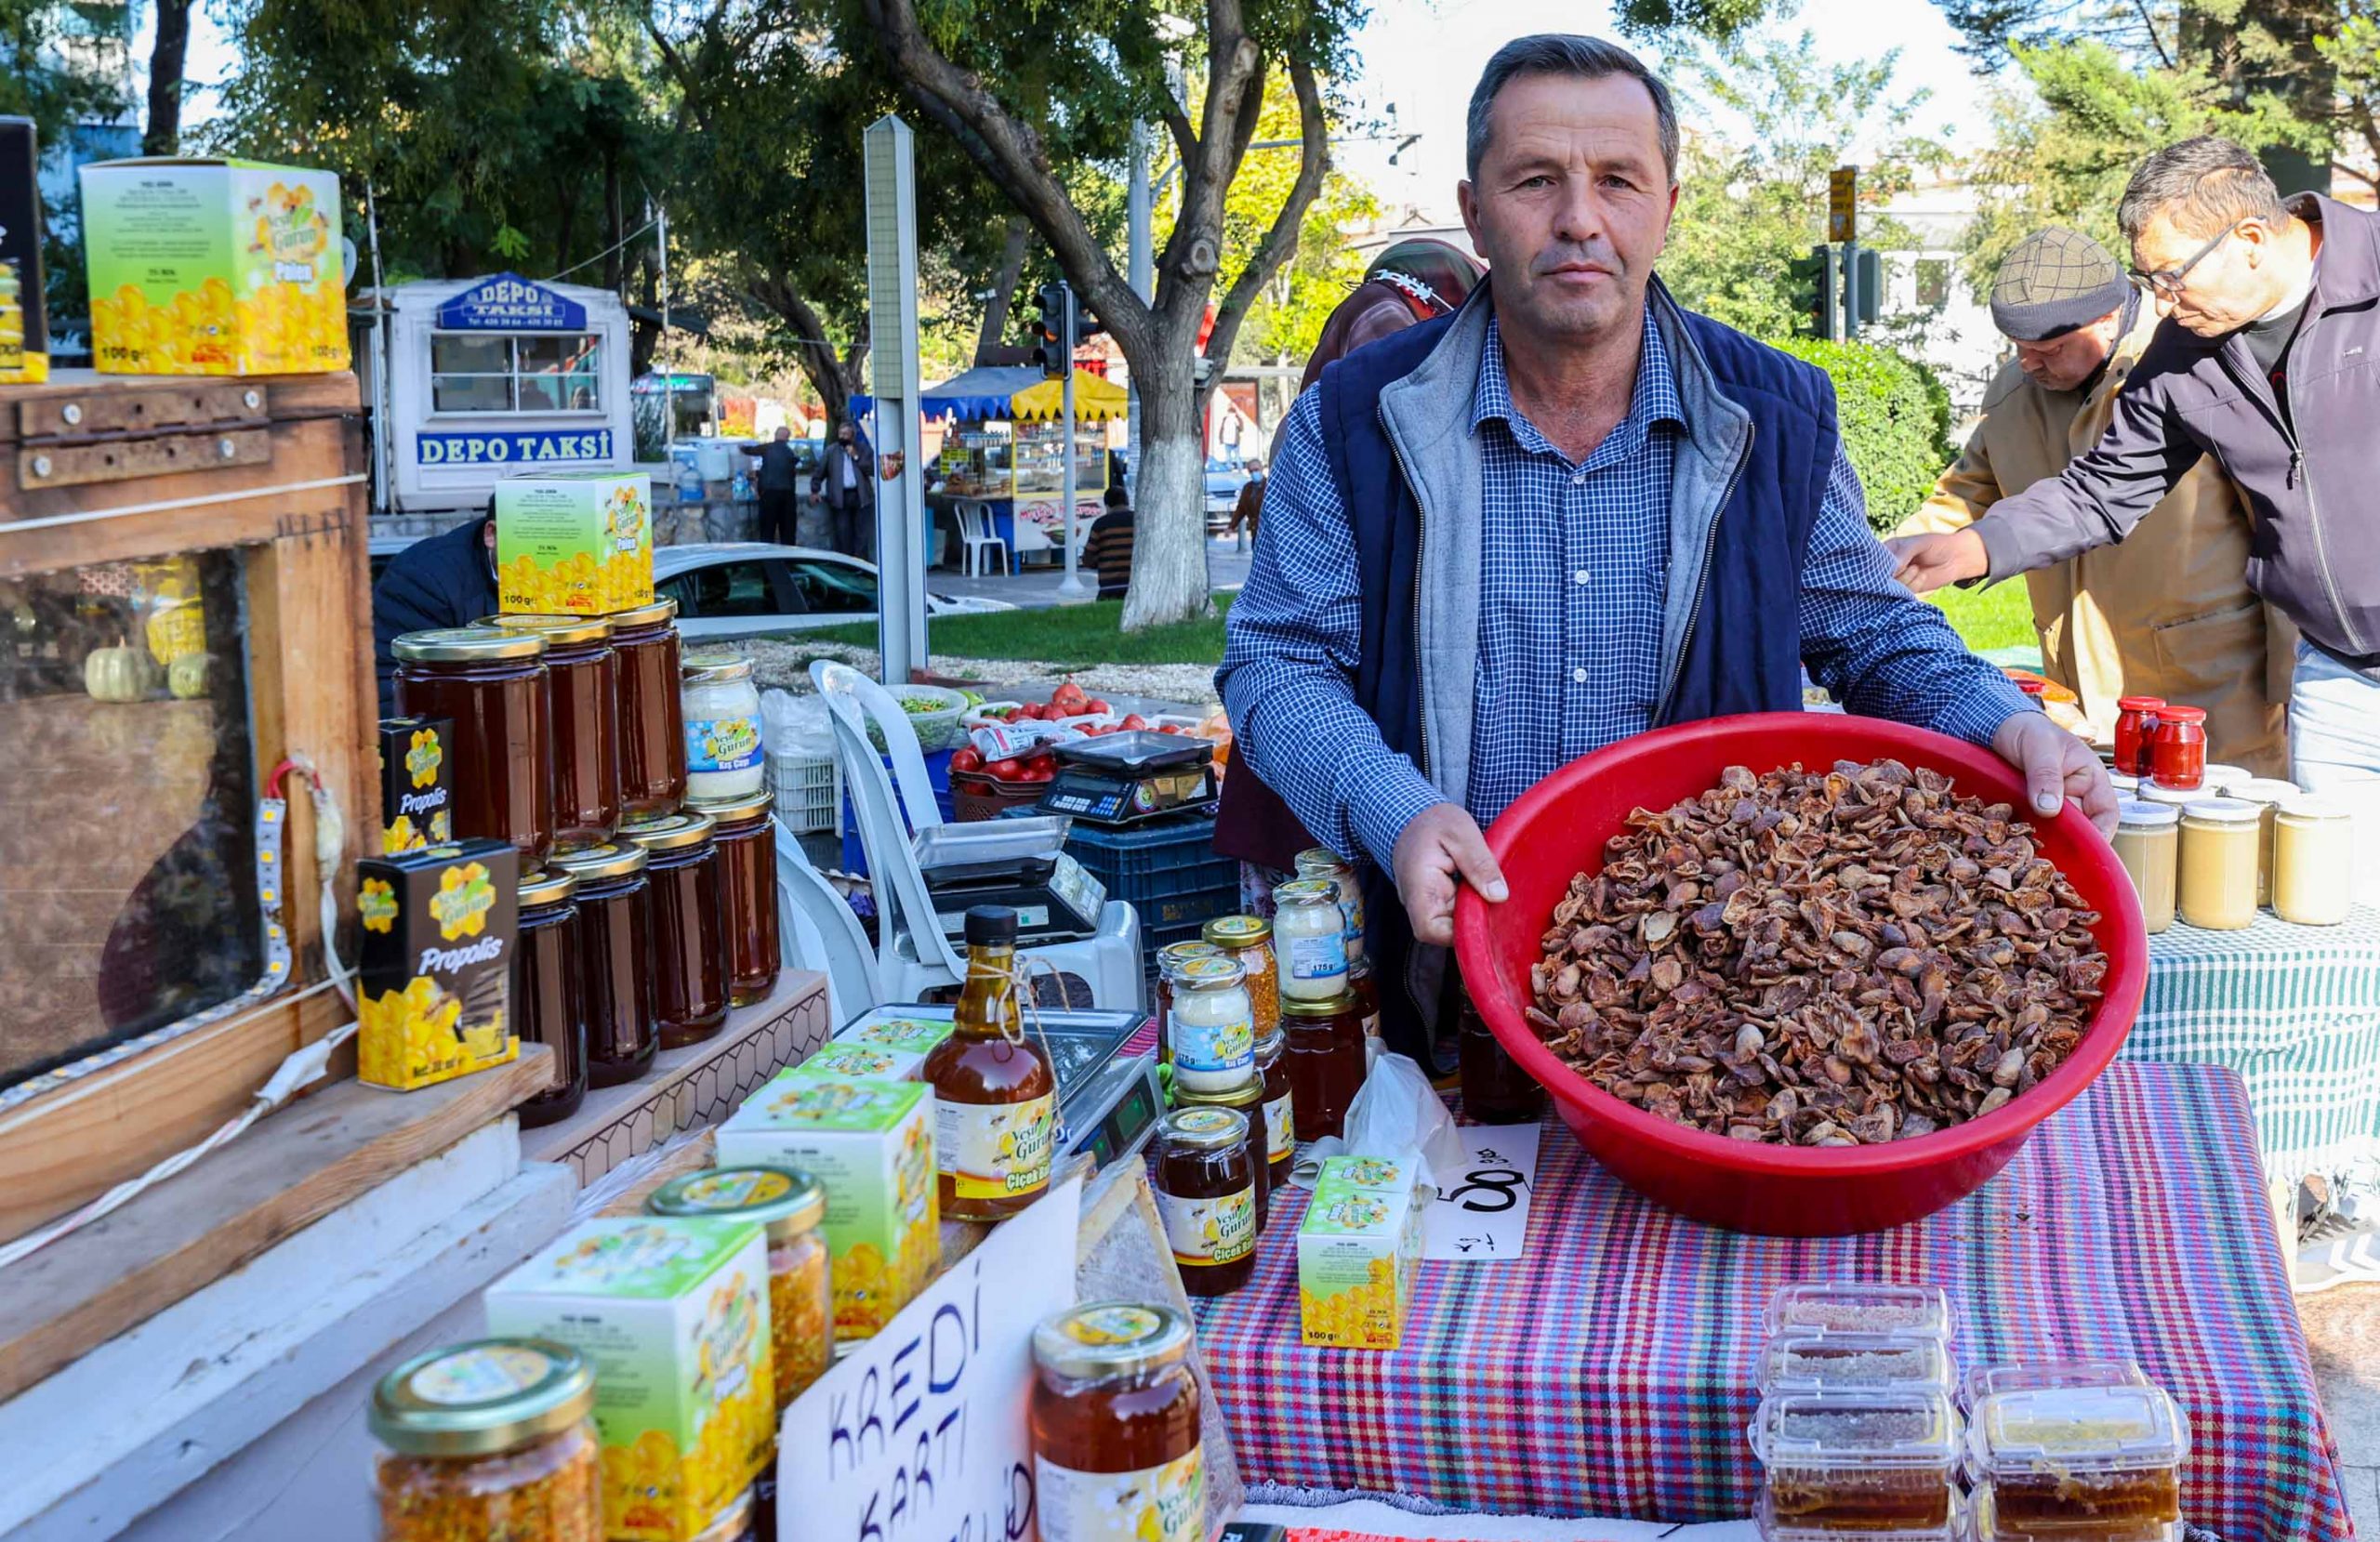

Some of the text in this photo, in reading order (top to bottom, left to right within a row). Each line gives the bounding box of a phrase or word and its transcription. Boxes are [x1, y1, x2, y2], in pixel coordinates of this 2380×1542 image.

[481, 281, 538, 303] DEPO
[102, 347, 127, 359] 100
[421, 430, 610, 464] DEPO TAKSİ
[504, 595, 522, 604] 100
[400, 786, 447, 815] Propolis
[418, 935, 503, 975] Propolis
[1313, 962, 1329, 971] 175
[1006, 1168, 1039, 1193] Çiçek
[1212, 1244, 1242, 1262] Çiçek
[1308, 1330, 1327, 1339] 100
[828, 1259, 981, 1483] KREDİ
